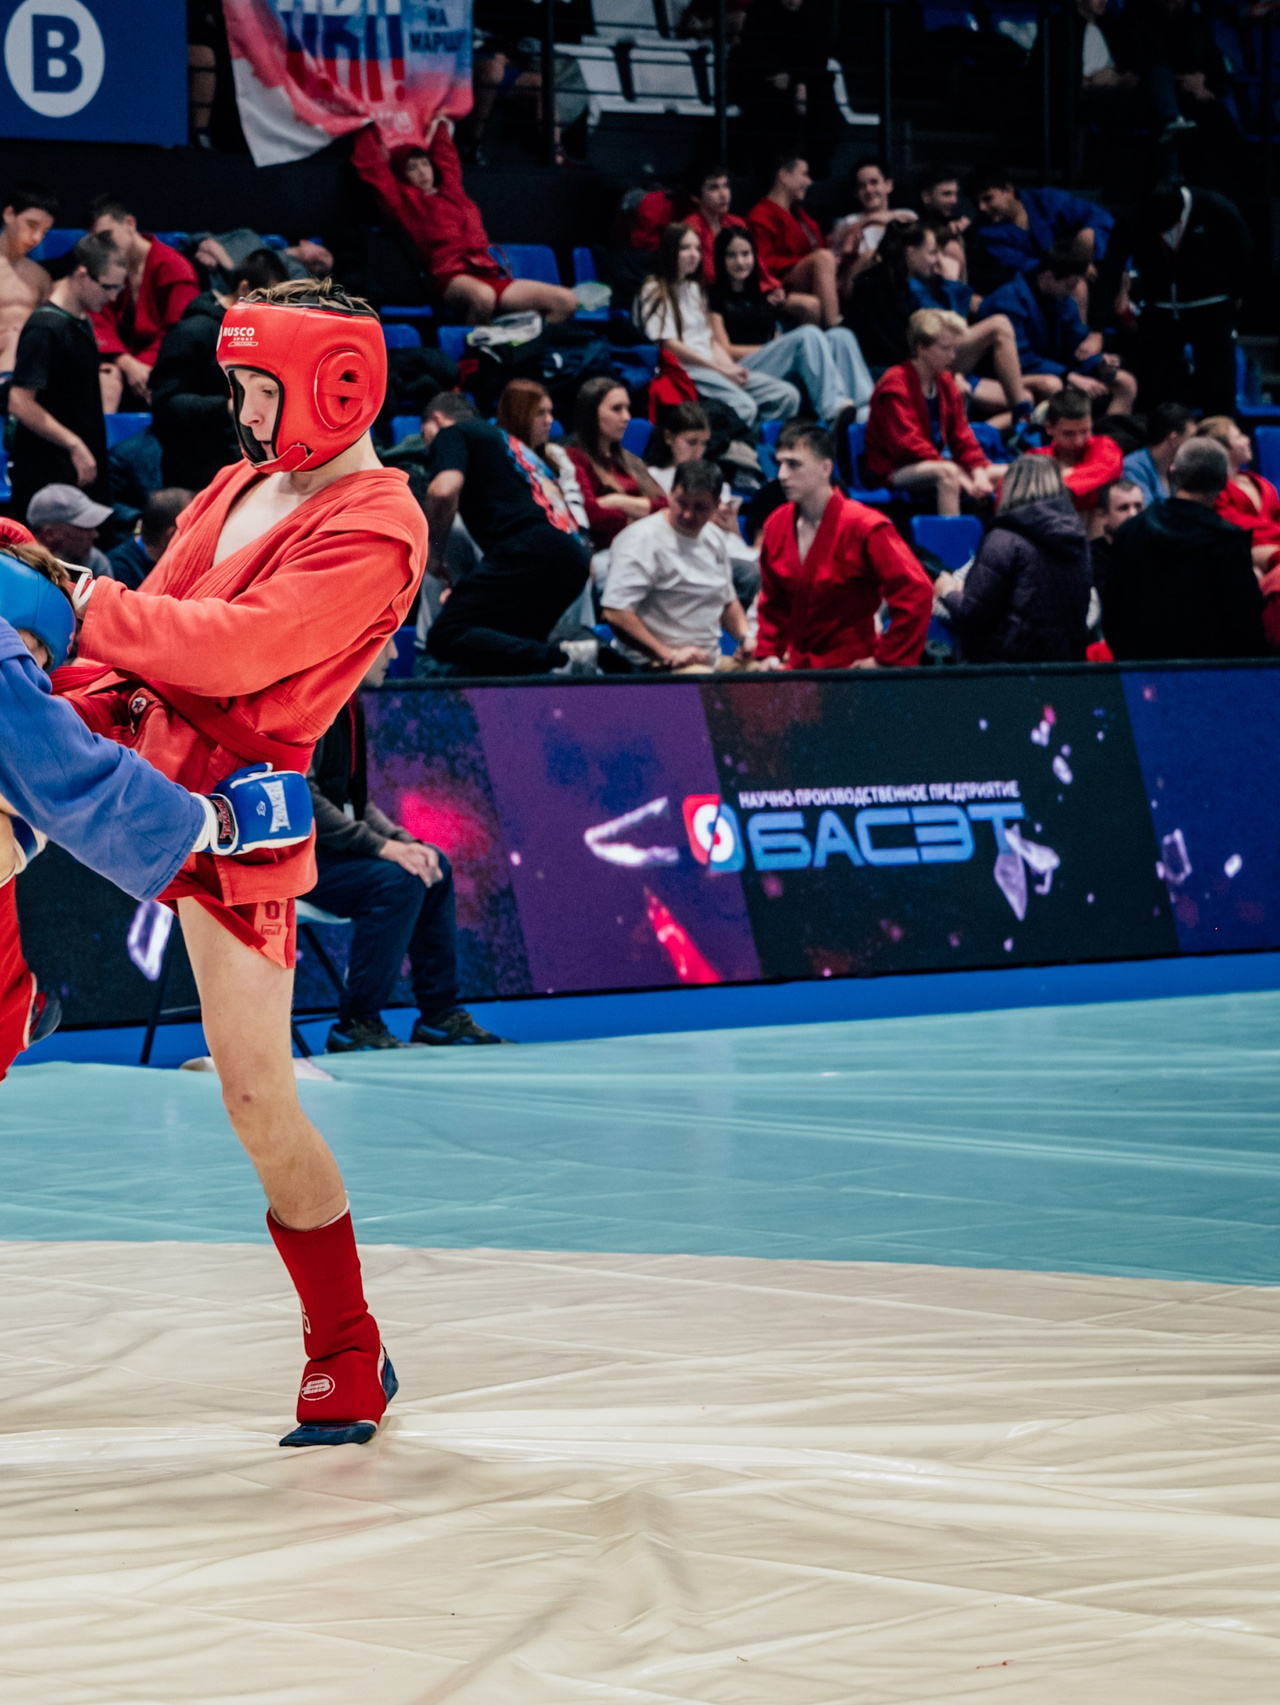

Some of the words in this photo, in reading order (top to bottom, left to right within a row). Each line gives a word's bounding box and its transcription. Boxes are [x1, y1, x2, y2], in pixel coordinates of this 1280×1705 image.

[223, 327, 255, 337] RUSCO
[738, 783, 928, 808] НАУЧНО-ПРОИЗВОДСТВЕННОЕ
[929, 780, 1020, 803] ПРЕДПРИЯТИЕ
[747, 801, 1025, 872] БАСЭТ
